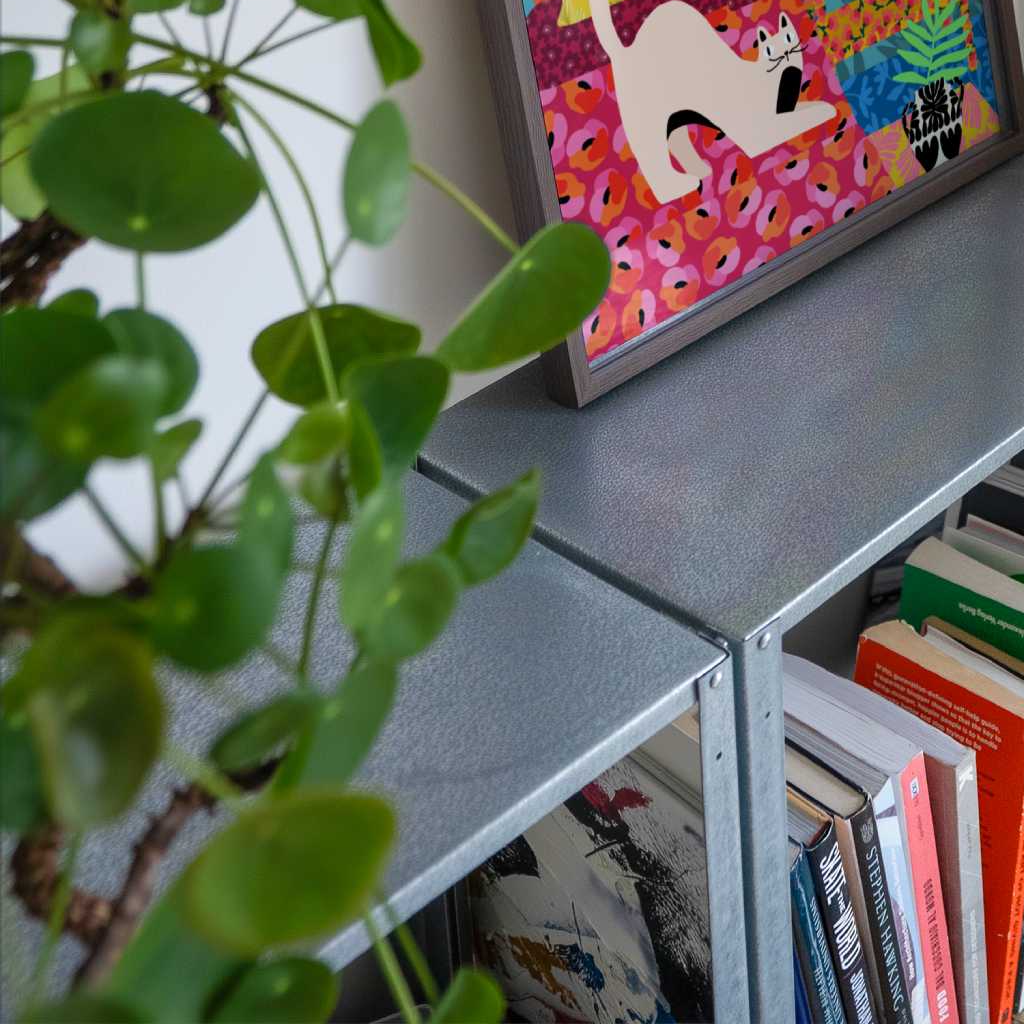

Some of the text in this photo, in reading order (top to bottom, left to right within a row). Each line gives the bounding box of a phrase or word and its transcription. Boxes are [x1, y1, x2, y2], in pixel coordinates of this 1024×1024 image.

[820, 841, 861, 970] SKATE THE WORLD
[866, 846, 889, 927] STEPHEN
[880, 926, 904, 1012] HAWKING
[933, 969, 945, 990] DAL
[935, 988, 950, 1023] FOOD
